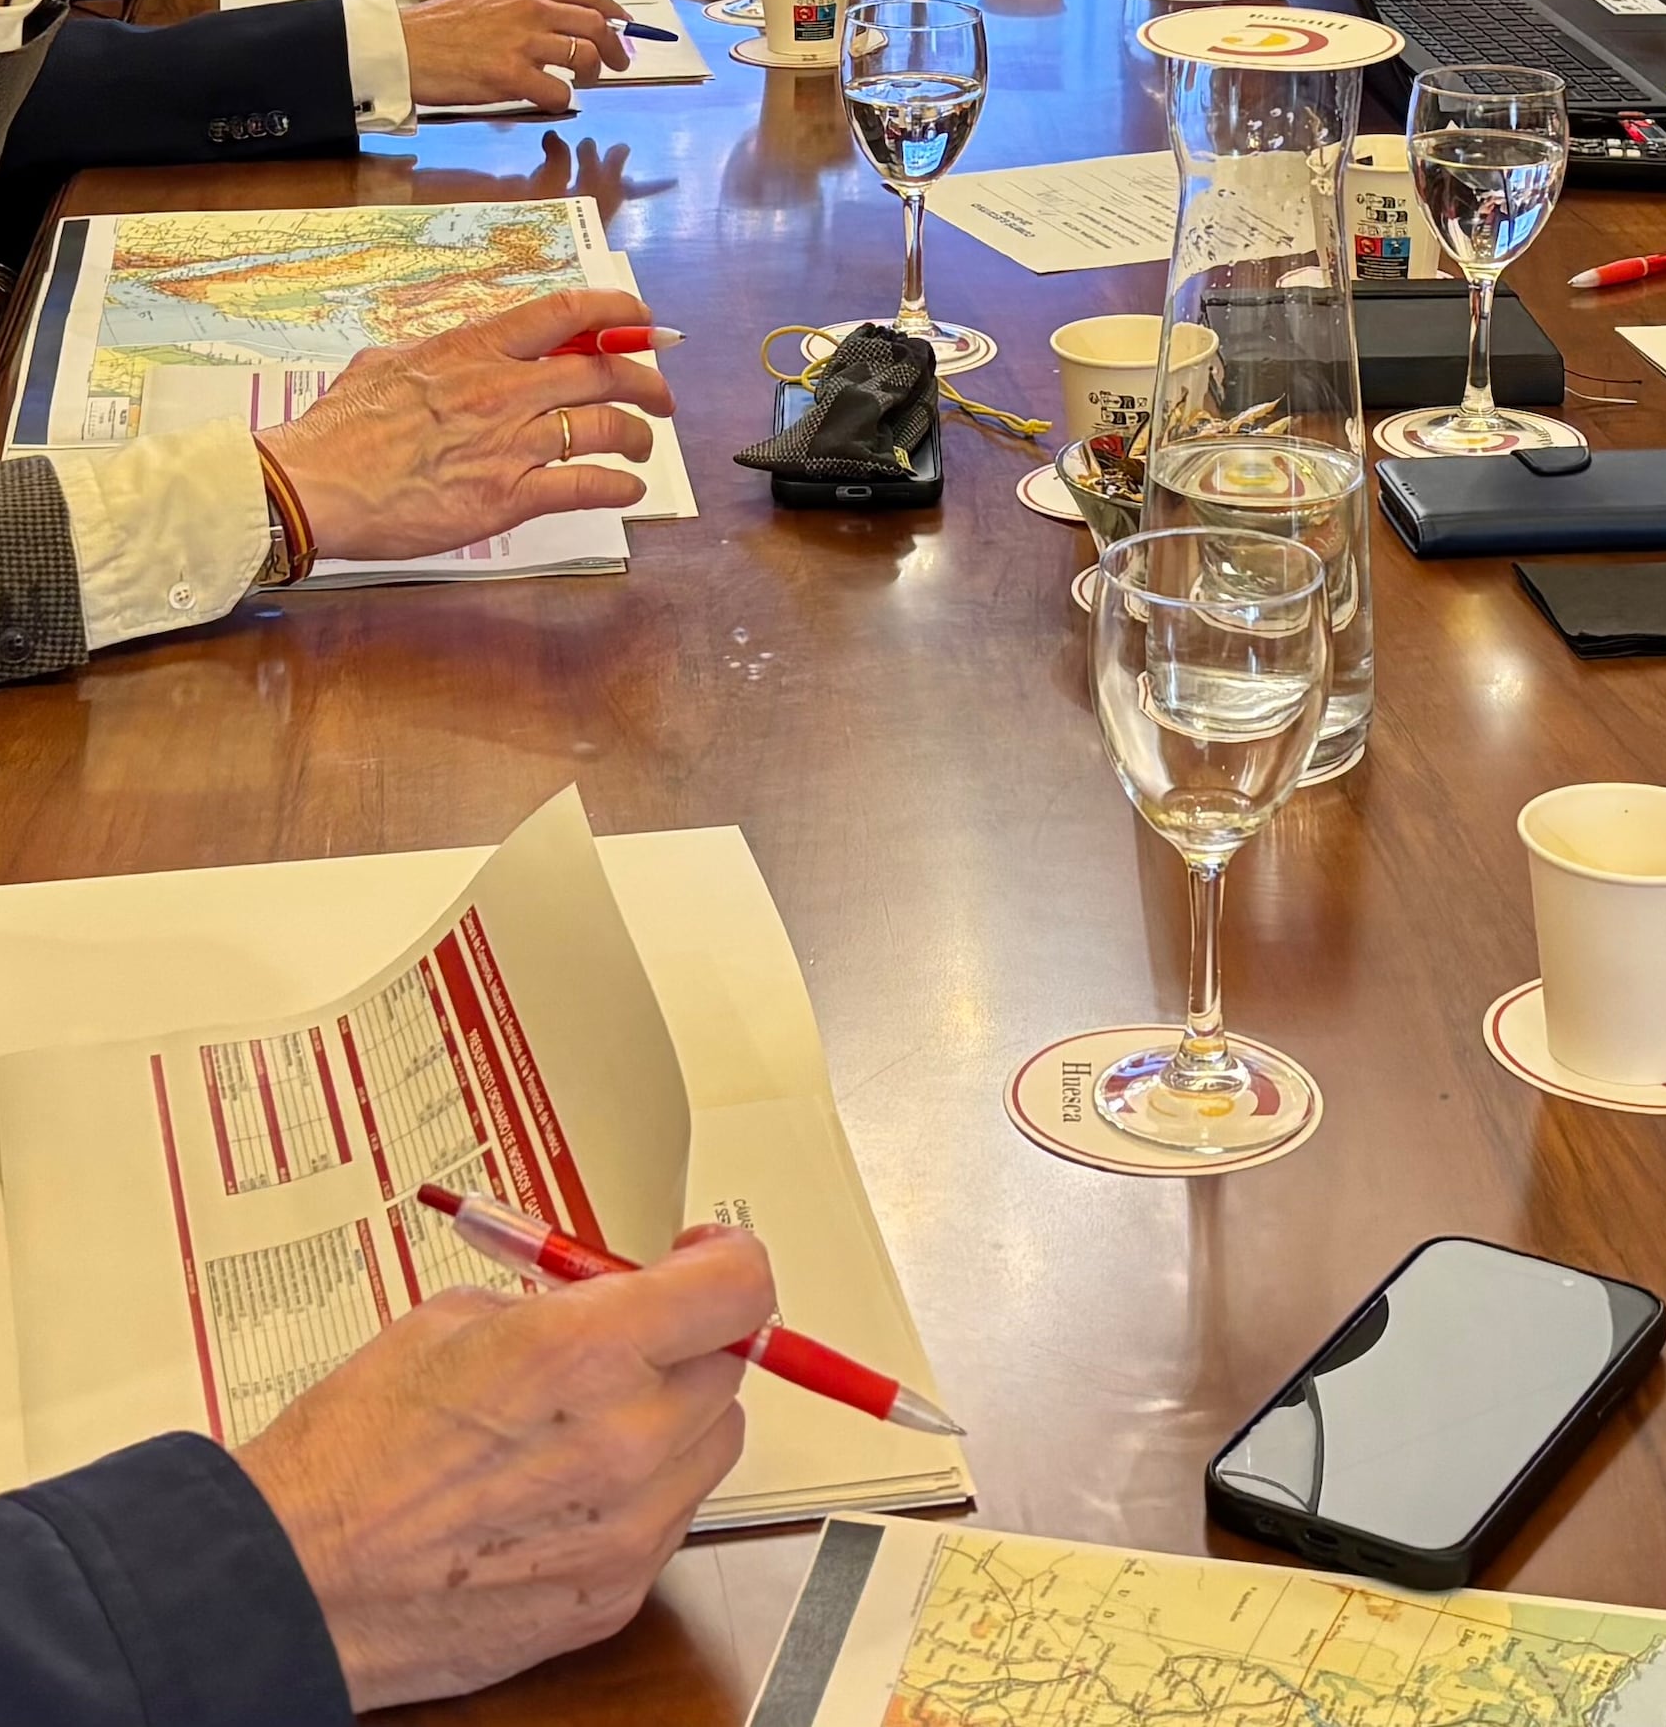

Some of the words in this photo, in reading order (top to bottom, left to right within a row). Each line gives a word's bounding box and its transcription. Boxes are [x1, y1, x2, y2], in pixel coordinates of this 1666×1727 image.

[468, 1028, 495, 1090] PRESUPUESTO
[517, 1054, 528, 1069] de
[487, 1087, 511, 1135] ORDINARIO
[525, 1072, 544, 1115] Provincia
[1060, 1059, 1083, 1125] Huesca
[502, 1131, 516, 1149] DE
[539, 1111, 550, 1126] de
[542, 1121, 562, 1157] Huesca
[507, 1144, 532, 1194] INGRESOS
